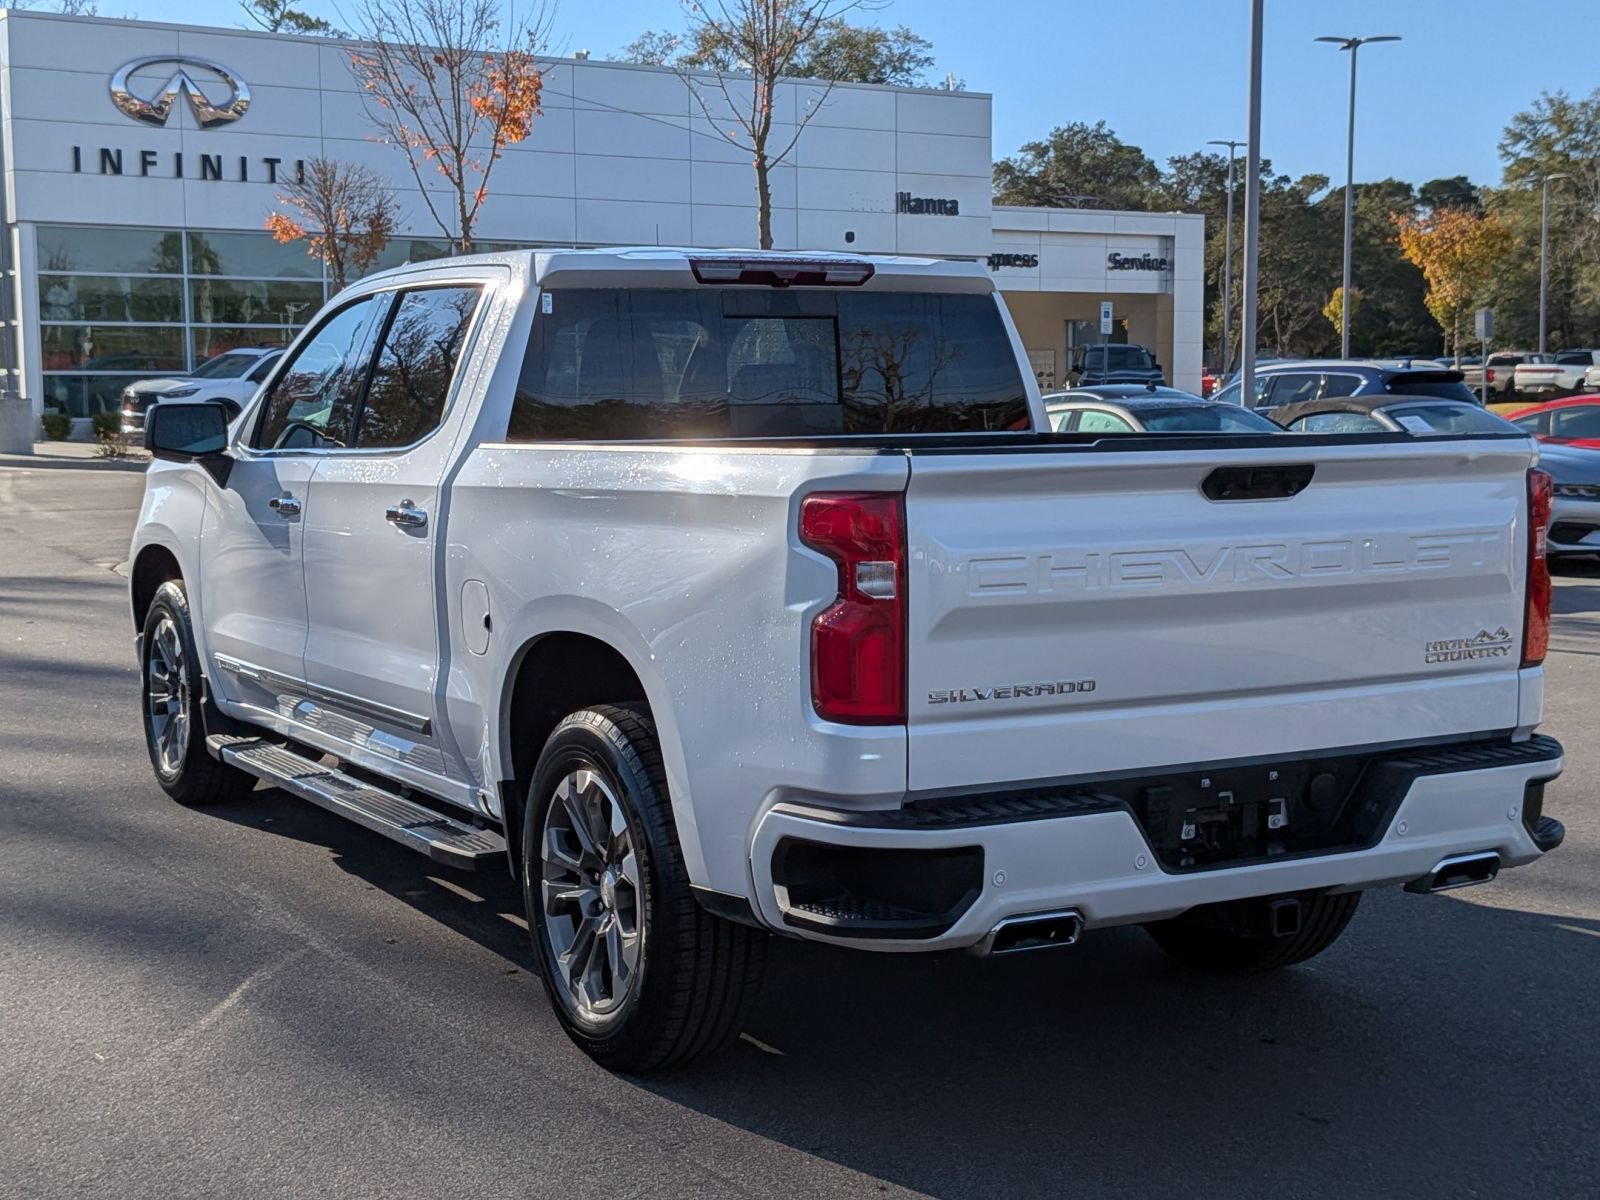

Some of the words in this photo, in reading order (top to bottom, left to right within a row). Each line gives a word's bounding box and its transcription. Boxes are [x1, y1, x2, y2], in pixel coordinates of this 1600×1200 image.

[73, 145, 305, 185] INFINITI
[896, 191, 959, 216] Hanna
[1107, 252, 1168, 272] Service
[967, 531, 1499, 597] CHEVROLET
[1425, 638, 1473, 653] HIGH
[1425, 644, 1512, 664] COUNTRY
[928, 679, 1097, 704] SILVERADO
